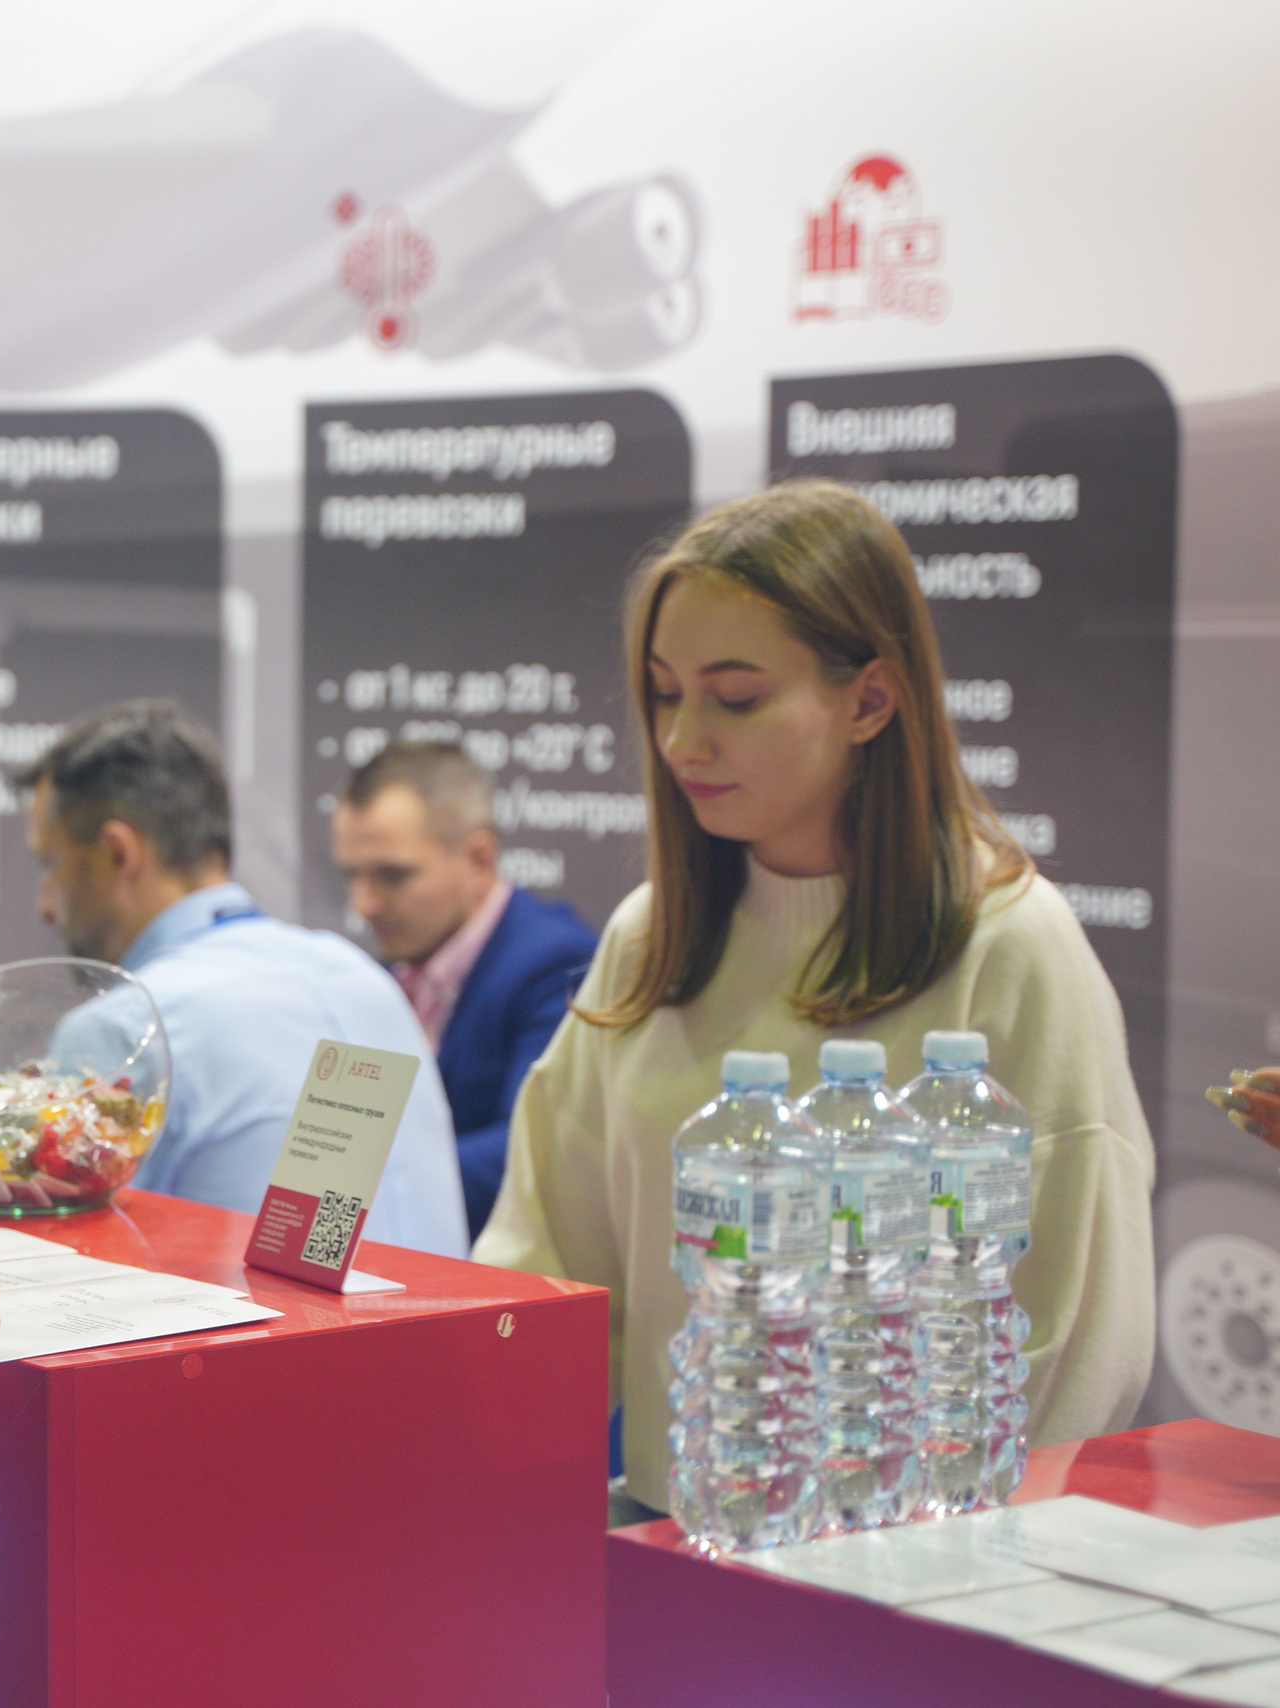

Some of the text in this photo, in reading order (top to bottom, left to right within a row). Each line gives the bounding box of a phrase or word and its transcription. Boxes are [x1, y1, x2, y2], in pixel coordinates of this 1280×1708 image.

[322, 420, 616, 481] Температурные
[788, 402, 956, 458] Внешняя
[322, 493, 526, 550] перевозки
[344, 669, 387, 712] от
[347, 1061, 382, 1080] ARTEL
